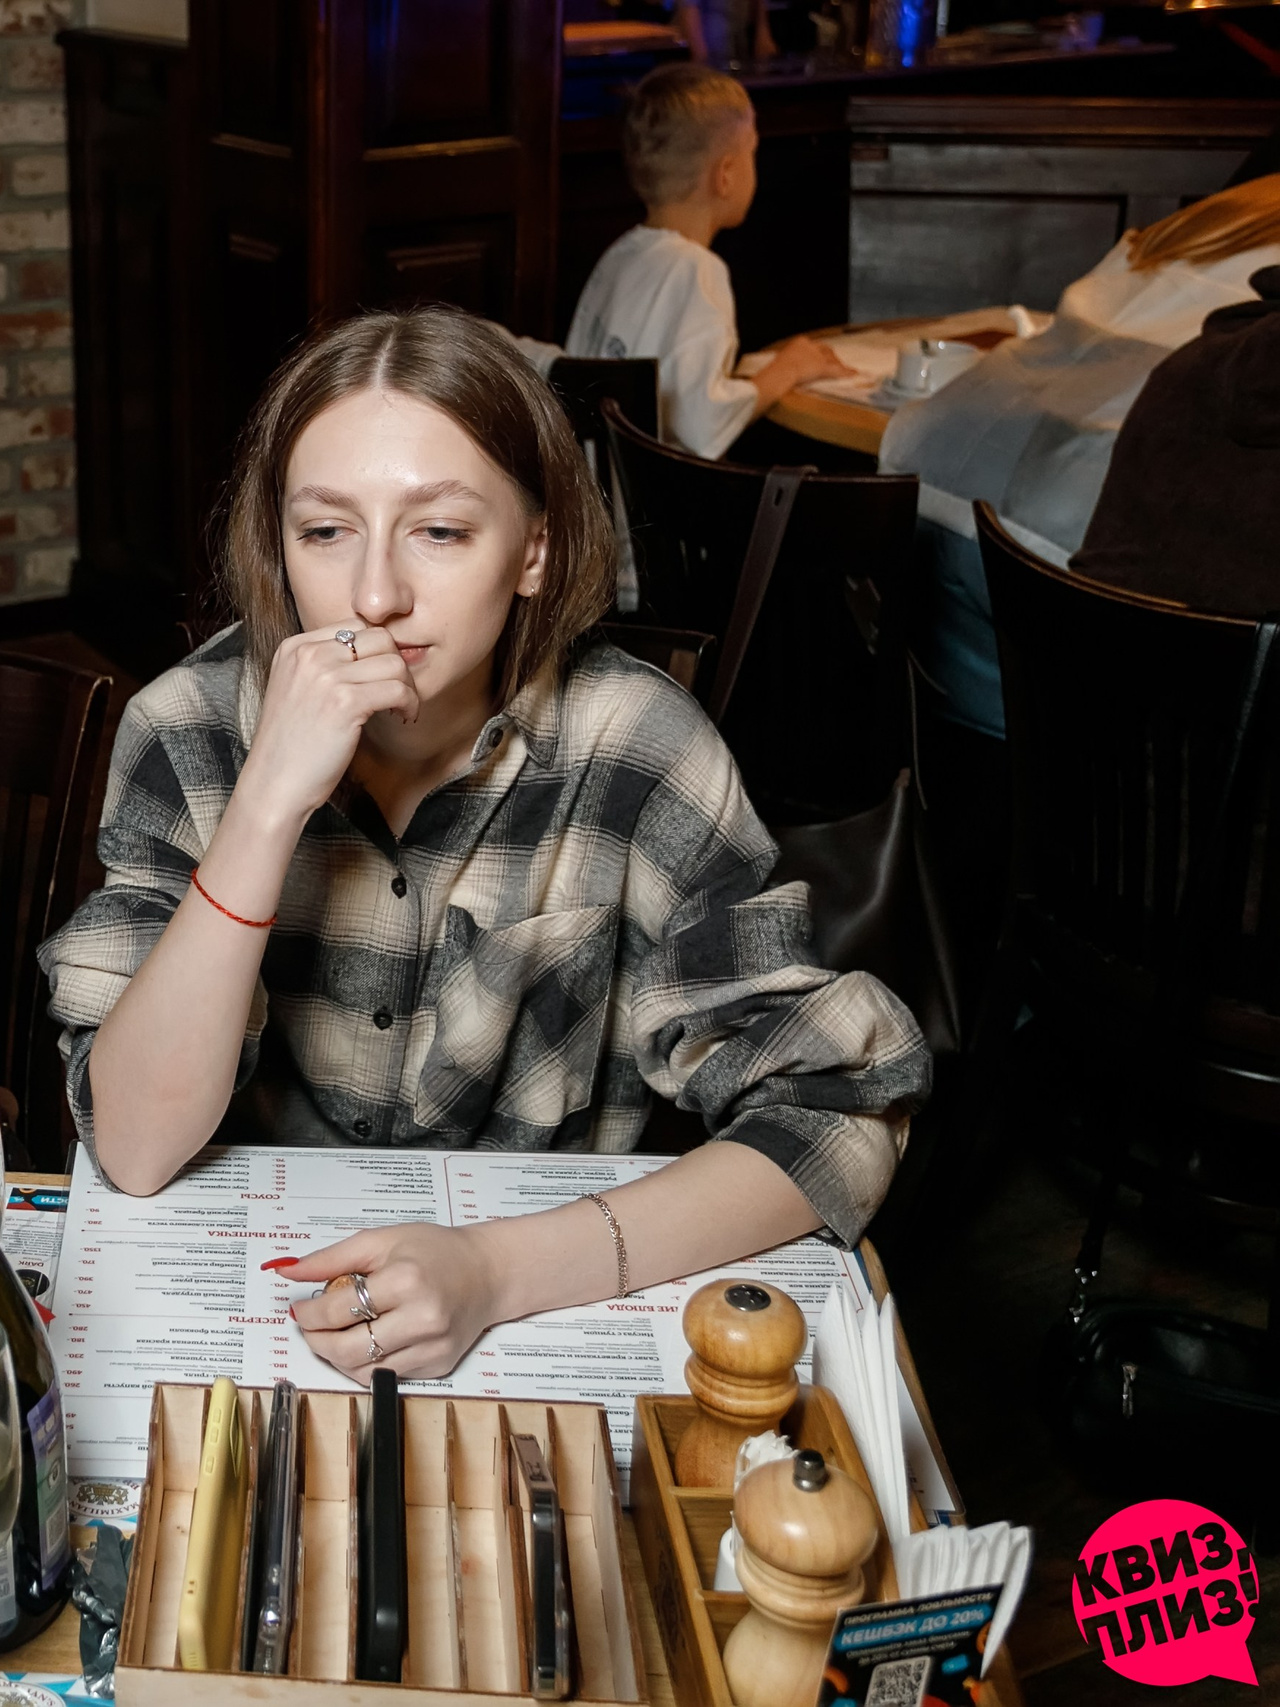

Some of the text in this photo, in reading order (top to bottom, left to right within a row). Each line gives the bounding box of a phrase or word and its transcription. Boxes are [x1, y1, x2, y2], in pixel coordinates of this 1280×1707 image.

[240, 1192, 280, 1200] СОУСЫ
[207, 1230, 266, 1238] ВЫПЕЧКА
[280, 1232, 311, 1240] ХЛЕБ
[606, 1304, 654, 1312] БЛЮДА
[228, 1316, 287, 1325] ДЕСЕРТЫ
[210, 1328, 244, 1336] Капуста
[210, 1340, 244, 1348] Капуста
[209, 1355, 243, 1364] Капуста
[844, 1592, 992, 1626] ПРОГРАММА ЛОЯЛЬНОСТИ
[841, 1609, 984, 1645] КЕШБЭК ДО 20%
